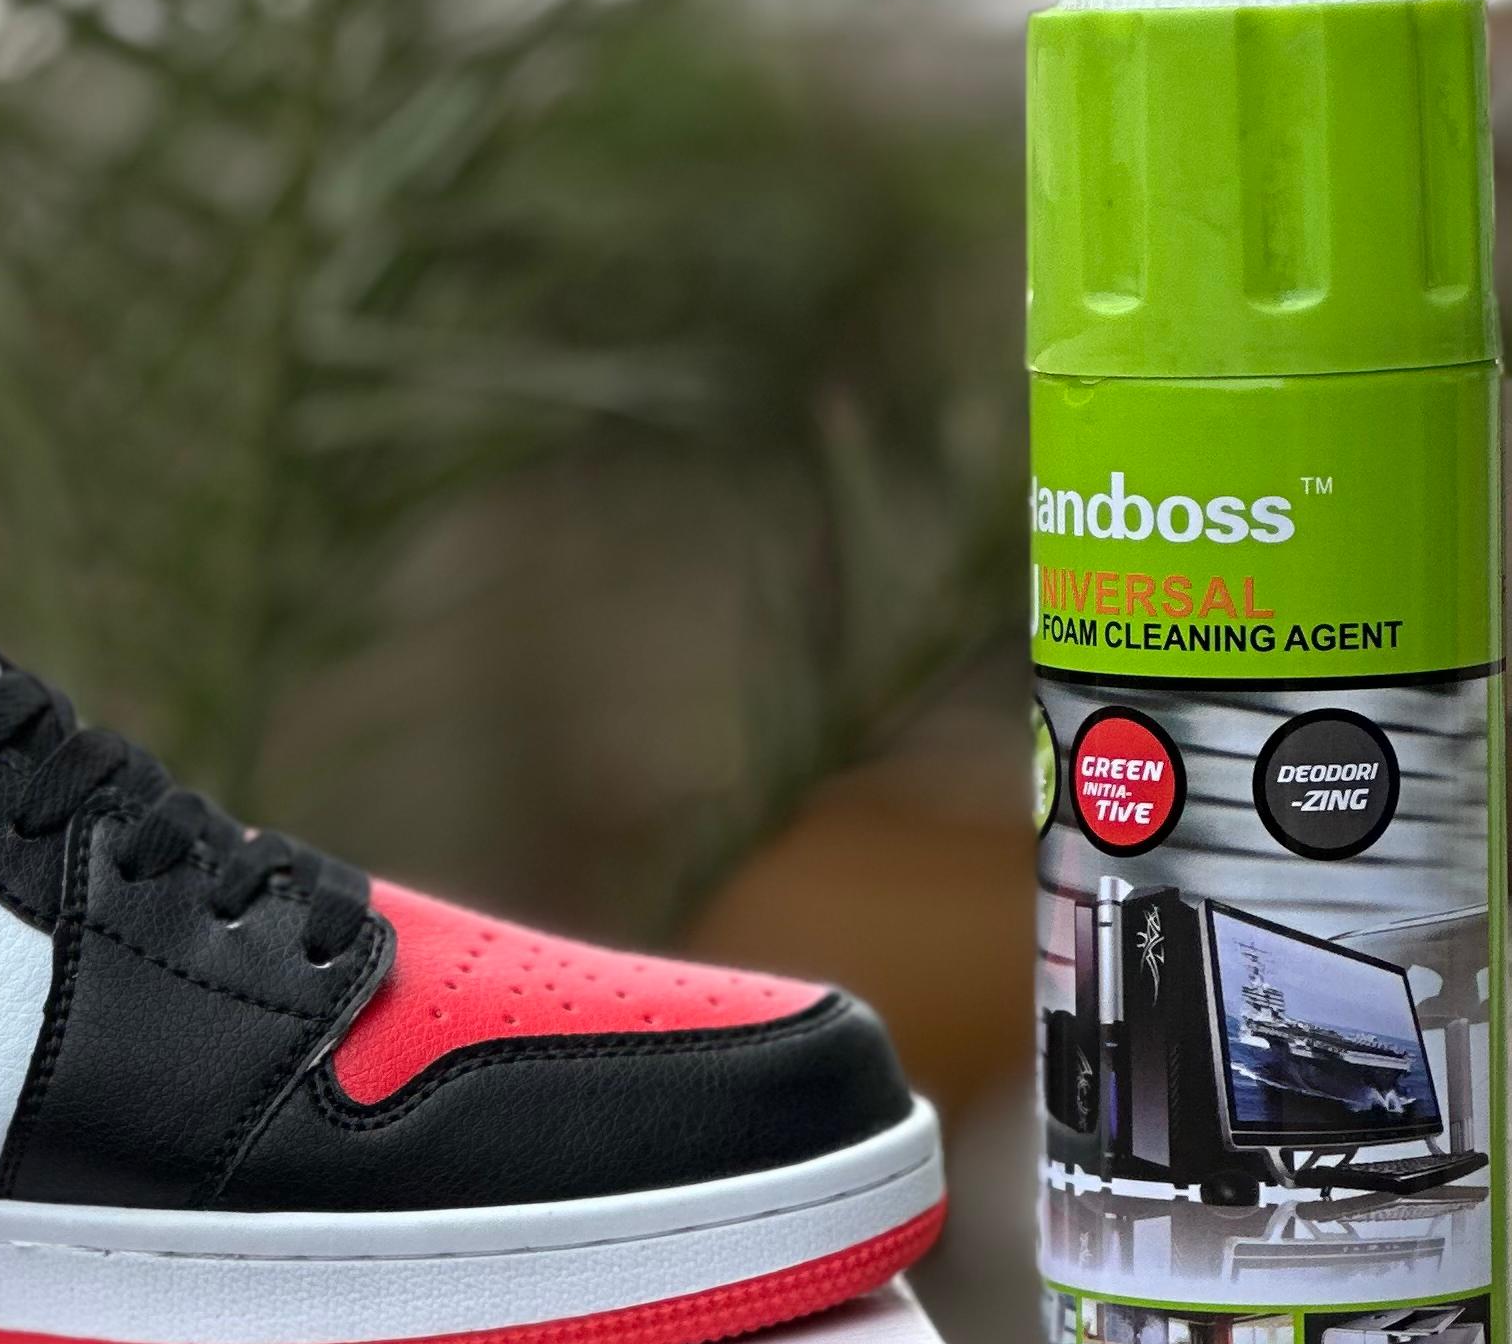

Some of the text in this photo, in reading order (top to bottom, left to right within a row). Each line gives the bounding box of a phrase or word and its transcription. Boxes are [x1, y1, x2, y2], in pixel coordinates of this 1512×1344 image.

[1300, 476, 1334, 496] TM
[1042, 613, 1404, 653] FOAM CLEANING AGENT
[1081, 755, 1165, 782] GREEN
[1276, 762, 1380, 783] DEODORI
[1082, 781, 1134, 799] INITIA-
[1291, 788, 1370, 812] -ZING
[1095, 799, 1155, 825] TIVE
